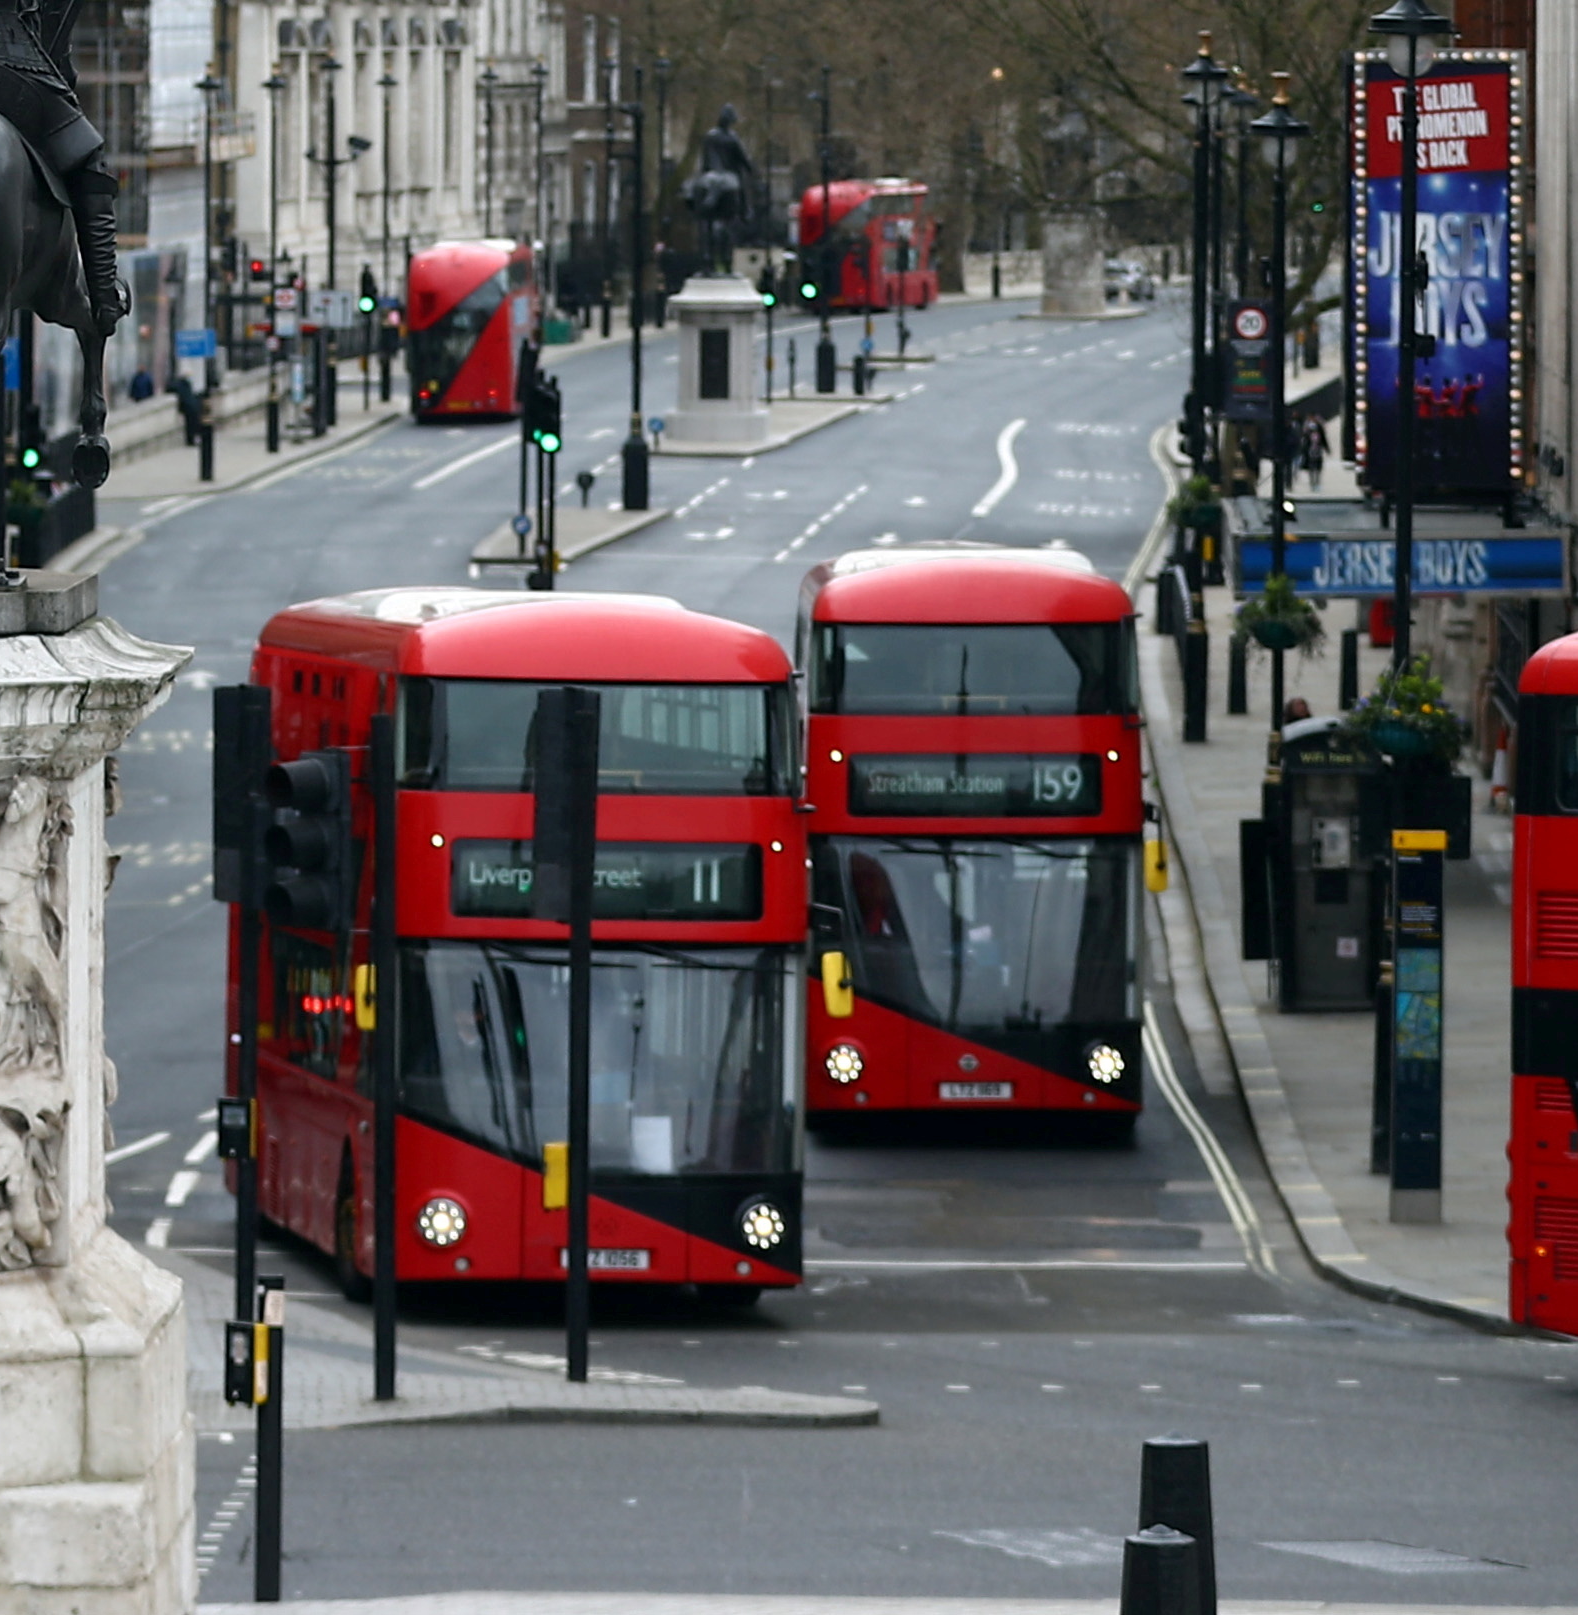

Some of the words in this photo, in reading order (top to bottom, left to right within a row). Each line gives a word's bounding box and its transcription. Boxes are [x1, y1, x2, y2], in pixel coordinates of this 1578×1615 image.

[1423, 83, 1477, 112] GLOBAL
[1386, 110, 1489, 142] PNOMENON
[1415, 141, 1427, 169] S
[1429, 139, 1469, 168] BACK
[1241, 314, 1261, 330] 20
[1314, 540, 1395, 587] JERSE
[1419, 539, 1488, 585] BOYS
[868, 770, 945, 794] Streatham
[949, 770, 1005, 794] Station
[1033, 764, 1083, 802] 159
[469, 861, 533, 892] Liverp
[692, 858, 720, 903] 11
